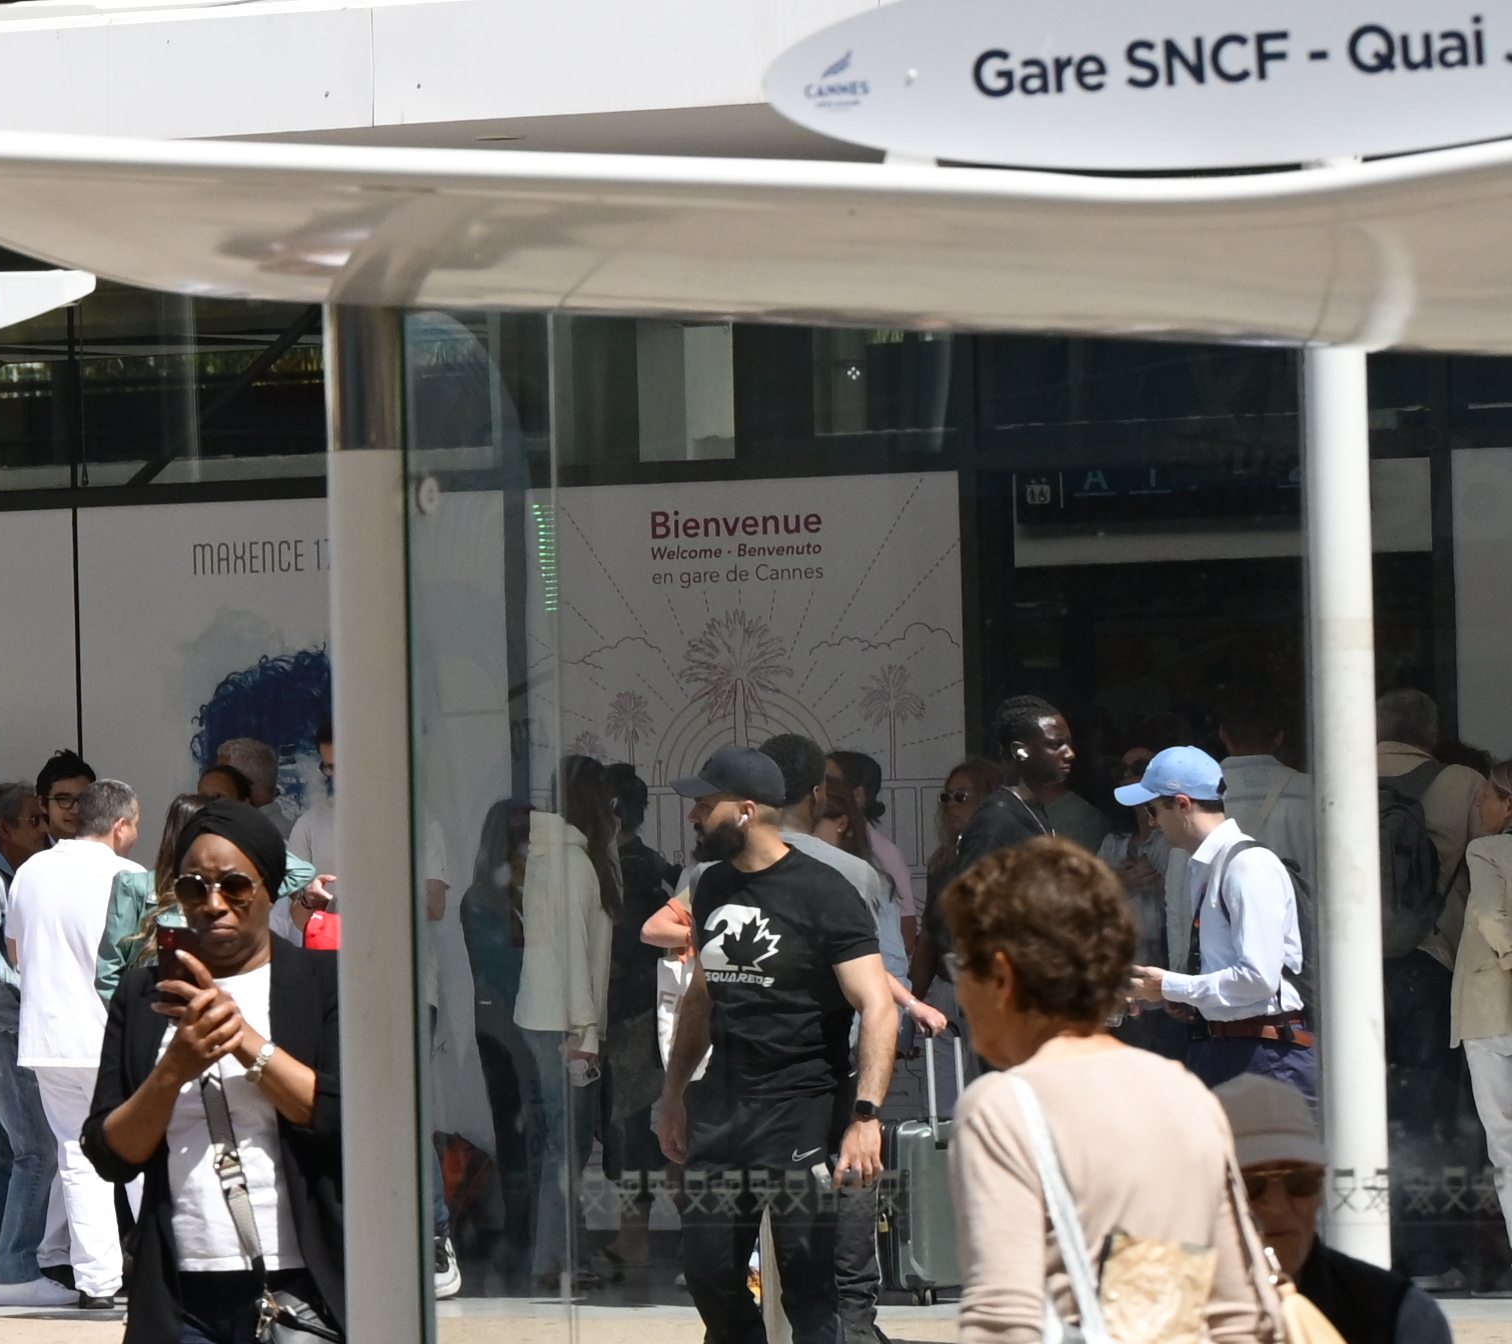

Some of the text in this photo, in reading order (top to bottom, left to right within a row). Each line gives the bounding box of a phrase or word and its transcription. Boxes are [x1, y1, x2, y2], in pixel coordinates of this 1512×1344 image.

[972, 15, 1486, 96] Gare SNCF Quai
[650, 510, 822, 539] Bienvenue
[192, 539, 305, 577] MAXENCE
[651, 542, 822, 560] Welcome Benvenuto
[652, 563, 824, 589] en gare de Cannes
[705, 972, 775, 988] SQUARED2
